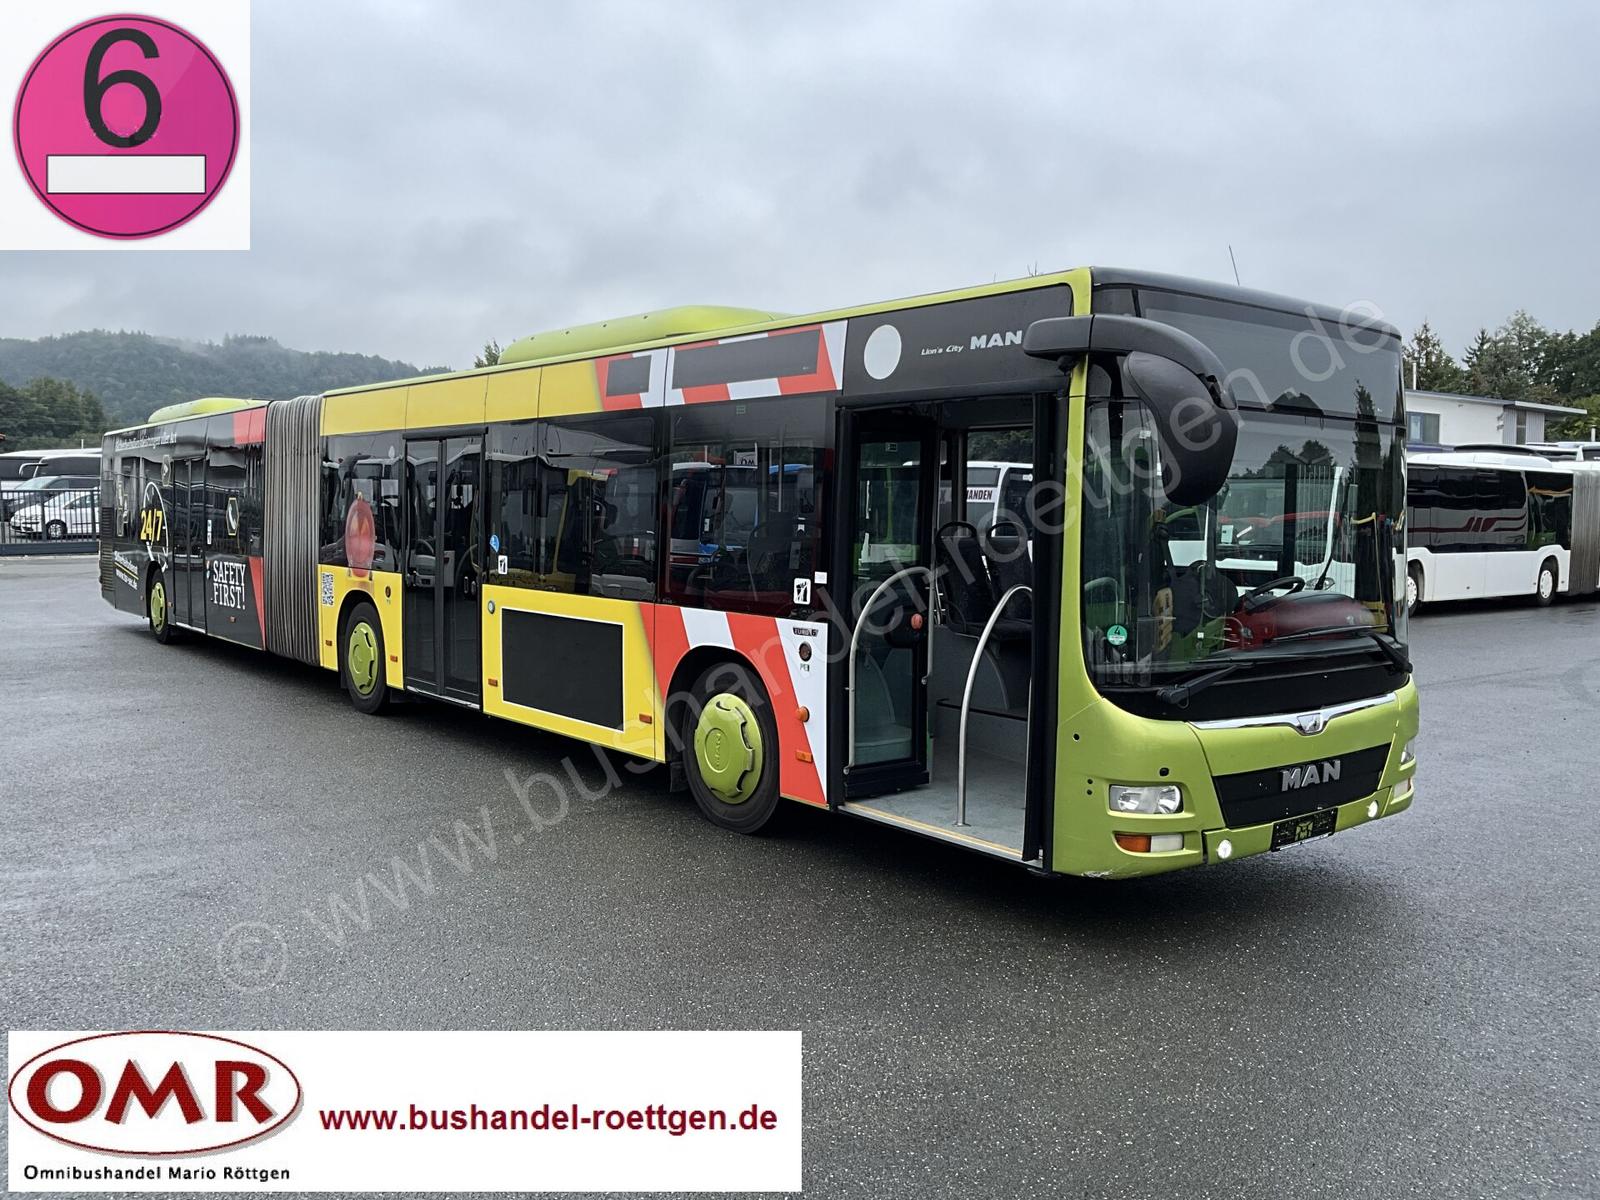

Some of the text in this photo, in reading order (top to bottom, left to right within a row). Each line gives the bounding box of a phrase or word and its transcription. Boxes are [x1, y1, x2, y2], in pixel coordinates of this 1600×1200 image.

[946, 344, 964, 353] City
[970, 330, 1022, 350] MAN
[140, 509, 163, 543] 24/7
[213, 560, 246, 587] SAFETY
[213, 583, 246, 610] FIRST!
[1280, 758, 1341, 792] MAN
